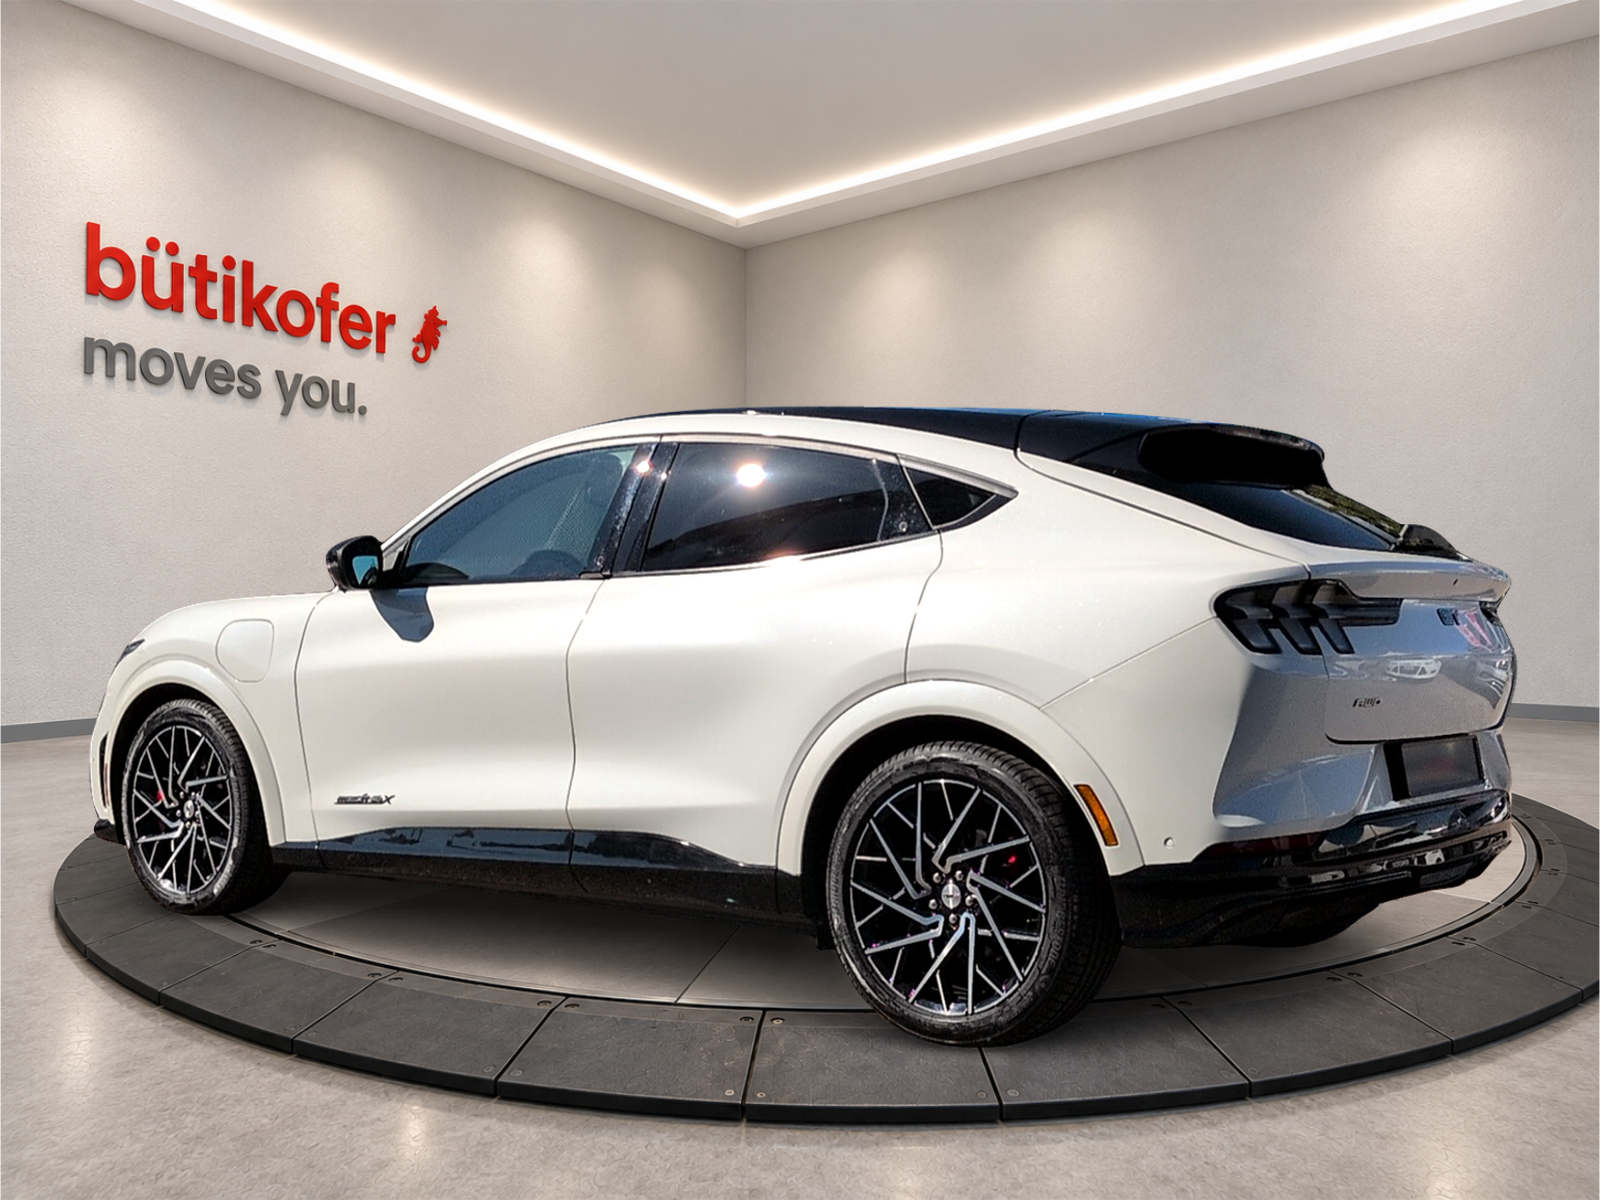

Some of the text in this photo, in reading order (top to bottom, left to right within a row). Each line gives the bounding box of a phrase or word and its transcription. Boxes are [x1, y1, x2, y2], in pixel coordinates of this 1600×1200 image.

[86, 221, 396, 353] bütikofer
[83, 336, 368, 416] moves you.
